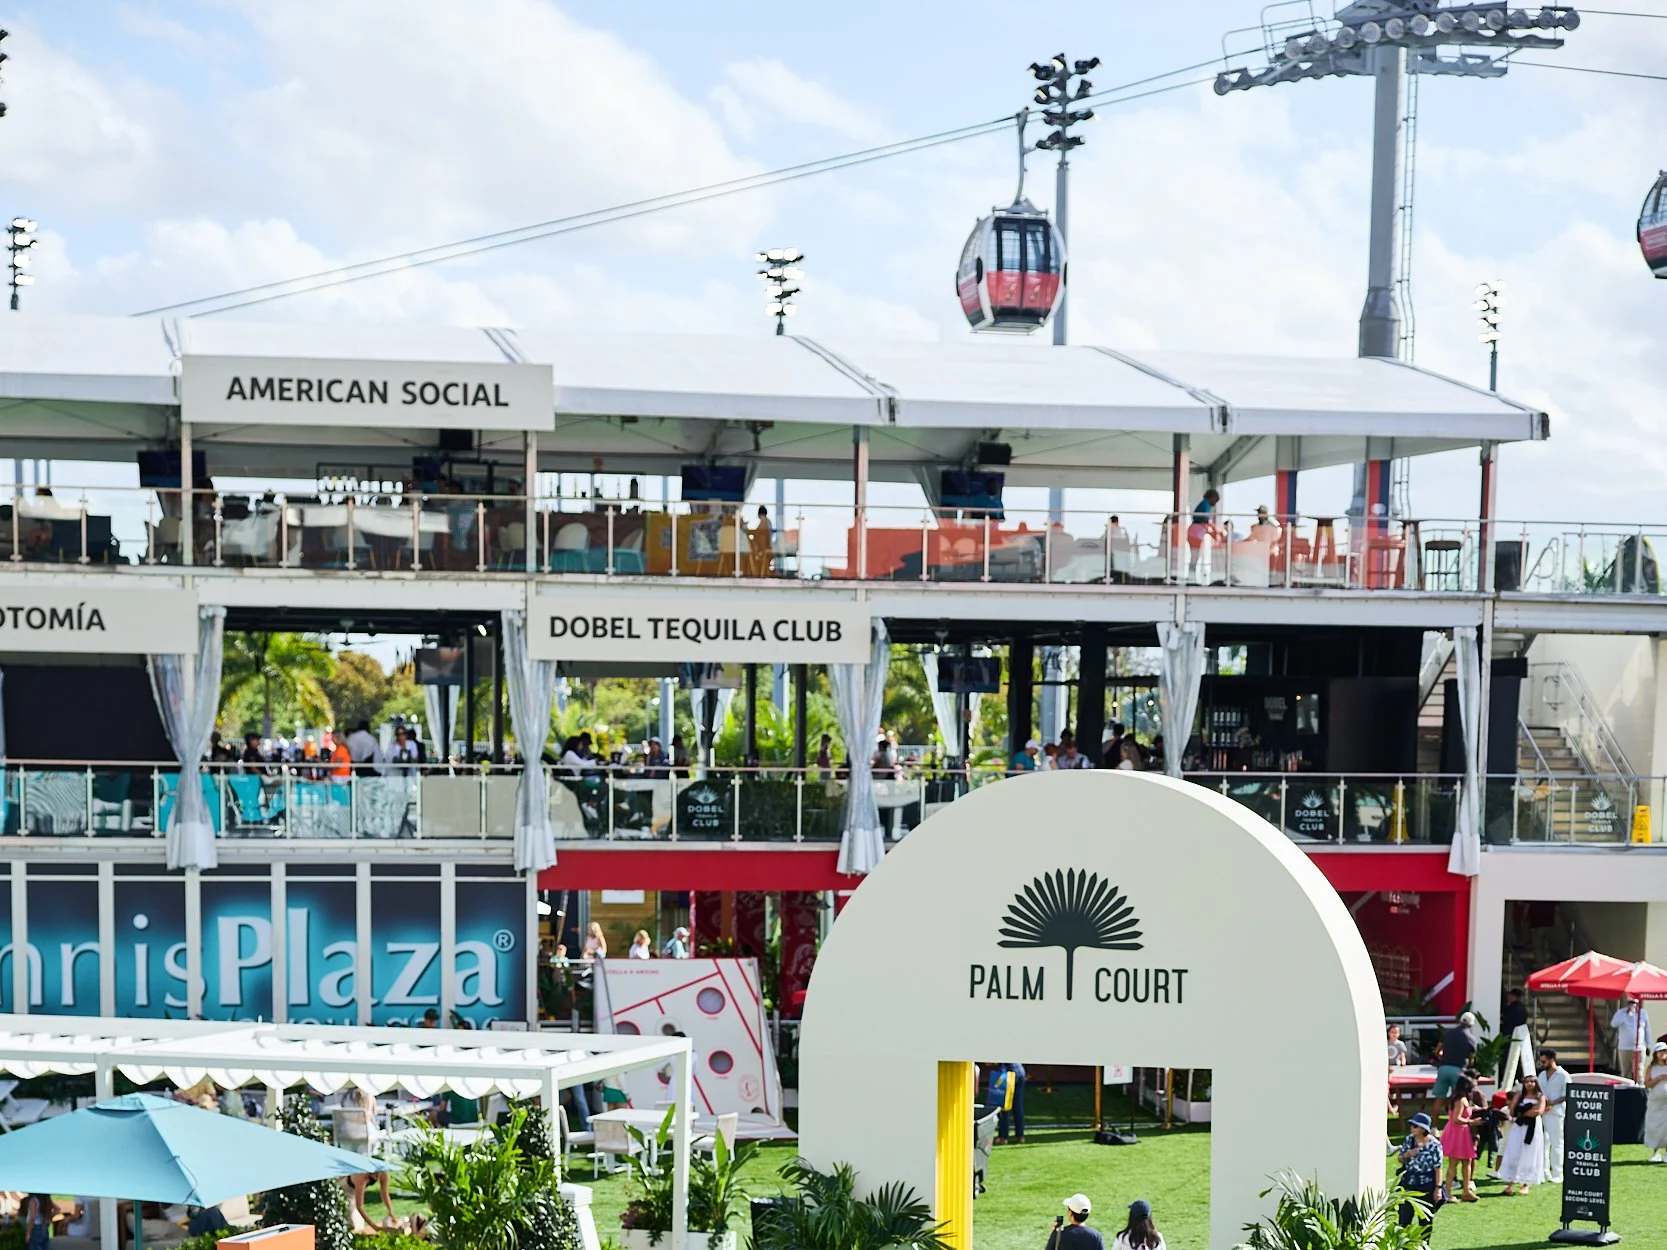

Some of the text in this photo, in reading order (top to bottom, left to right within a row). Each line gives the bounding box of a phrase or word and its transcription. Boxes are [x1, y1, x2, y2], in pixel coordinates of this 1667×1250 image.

[226, 376, 509, 407] AMERICAN SOCIAL
[0, 601, 106, 631] TOMÍA
[550, 616, 842, 643] DOBEL TEQUILA CLUB
[692, 819, 719, 827] CLUB
[1588, 825, 1613, 833] CLUB
[970, 964, 1189, 1004] PALM COURT
[1570, 1090, 1609, 1100] ELEVATE
[1576, 1101, 1602, 1110] YOUR
[1575, 1112, 1602, 1121] GAME
[1568, 1151, 1607, 1161] DOBEL
[1572, 1167, 1600, 1176] CLUB
